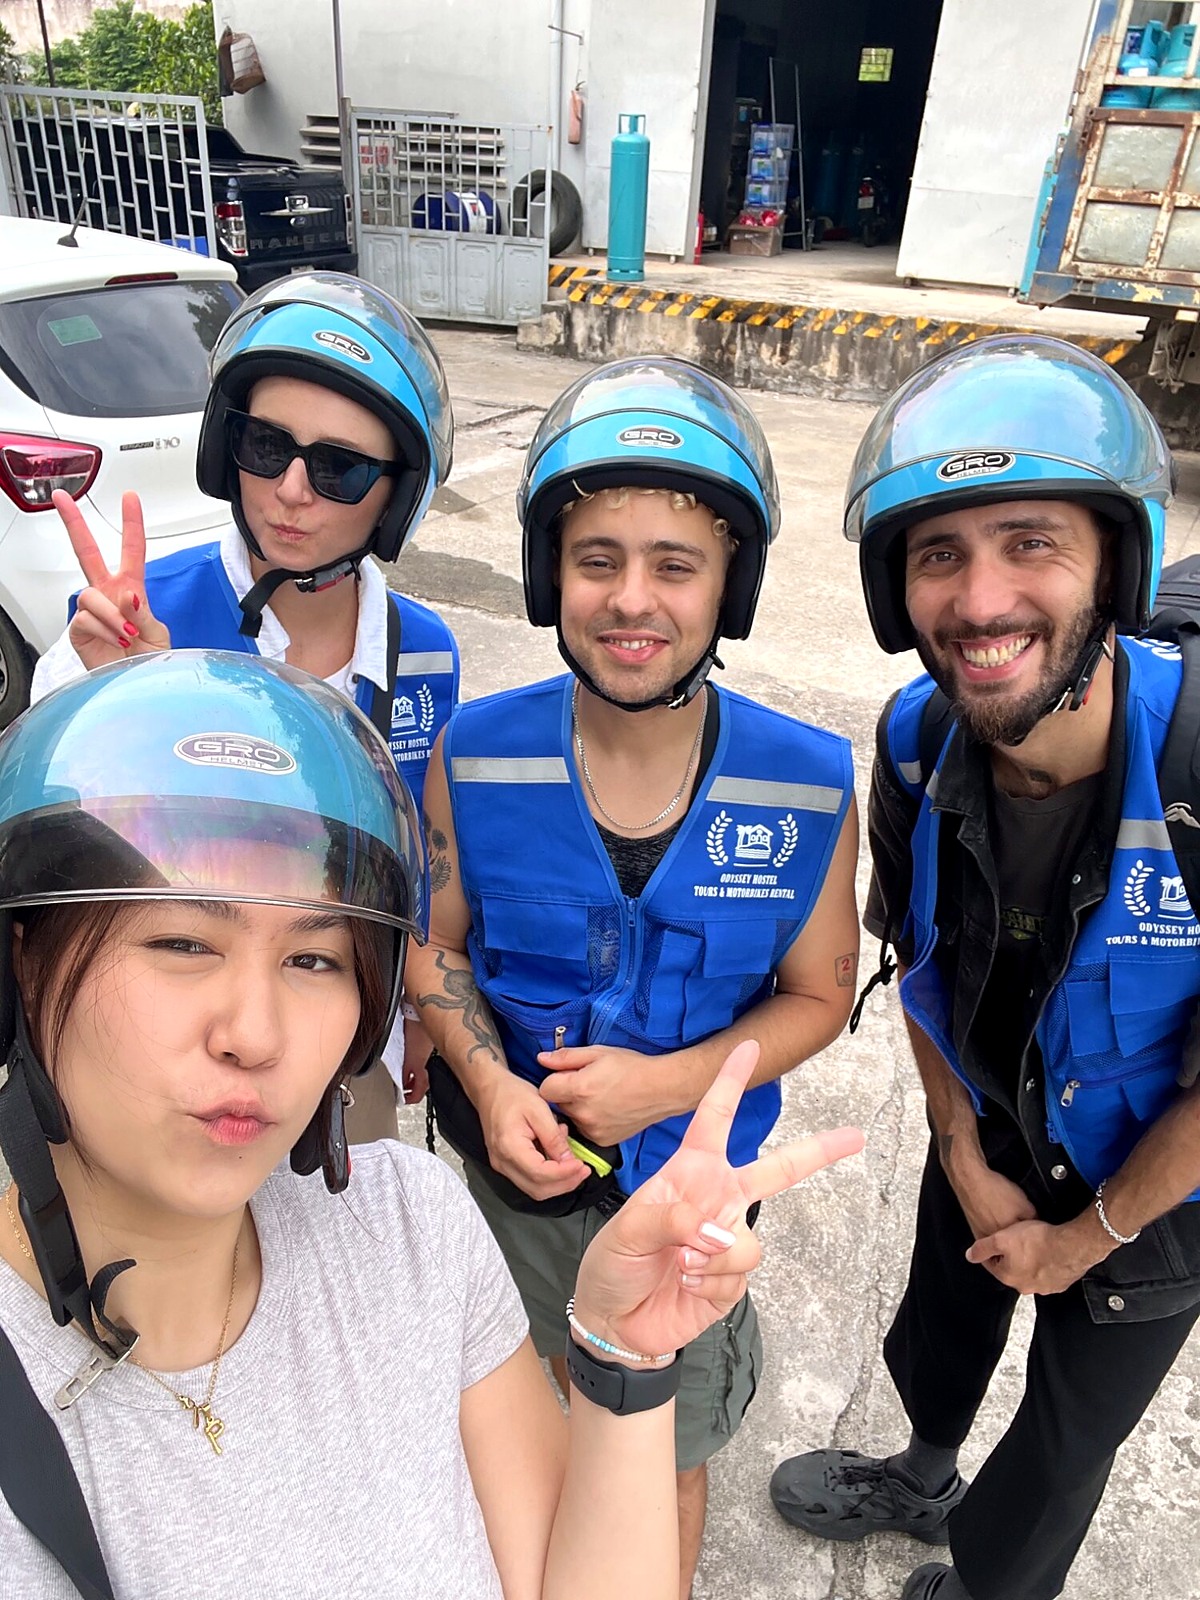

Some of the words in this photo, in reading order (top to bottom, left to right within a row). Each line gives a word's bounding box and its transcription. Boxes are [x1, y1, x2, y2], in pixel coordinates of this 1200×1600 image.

[249, 231, 346, 250] RANGER
[319, 332, 366, 356] GRO
[624, 430, 675, 442] GRO
[946, 454, 1004, 473] GRO
[407, 737, 430, 749] HOSTEL
[193, 740, 281, 763] GRO
[210, 757, 265, 769] HELMET
[720, 873, 752, 884] ODYSSEY
[752, 874, 778, 885] HOSTEL
[693, 886, 718, 897] TOURS
[718, 887, 725, 898] &
[725, 886, 769, 898] MOTORBIKES
[769, 888, 795, 899] RENTAL
[1138, 922, 1184, 935] ODYSSEY
[1187, 924, 1200, 935] HO
[1105, 935, 1138, 945] TOURS
[1140, 936, 1148, 945] &
[841, 957, 851, 972] 2
